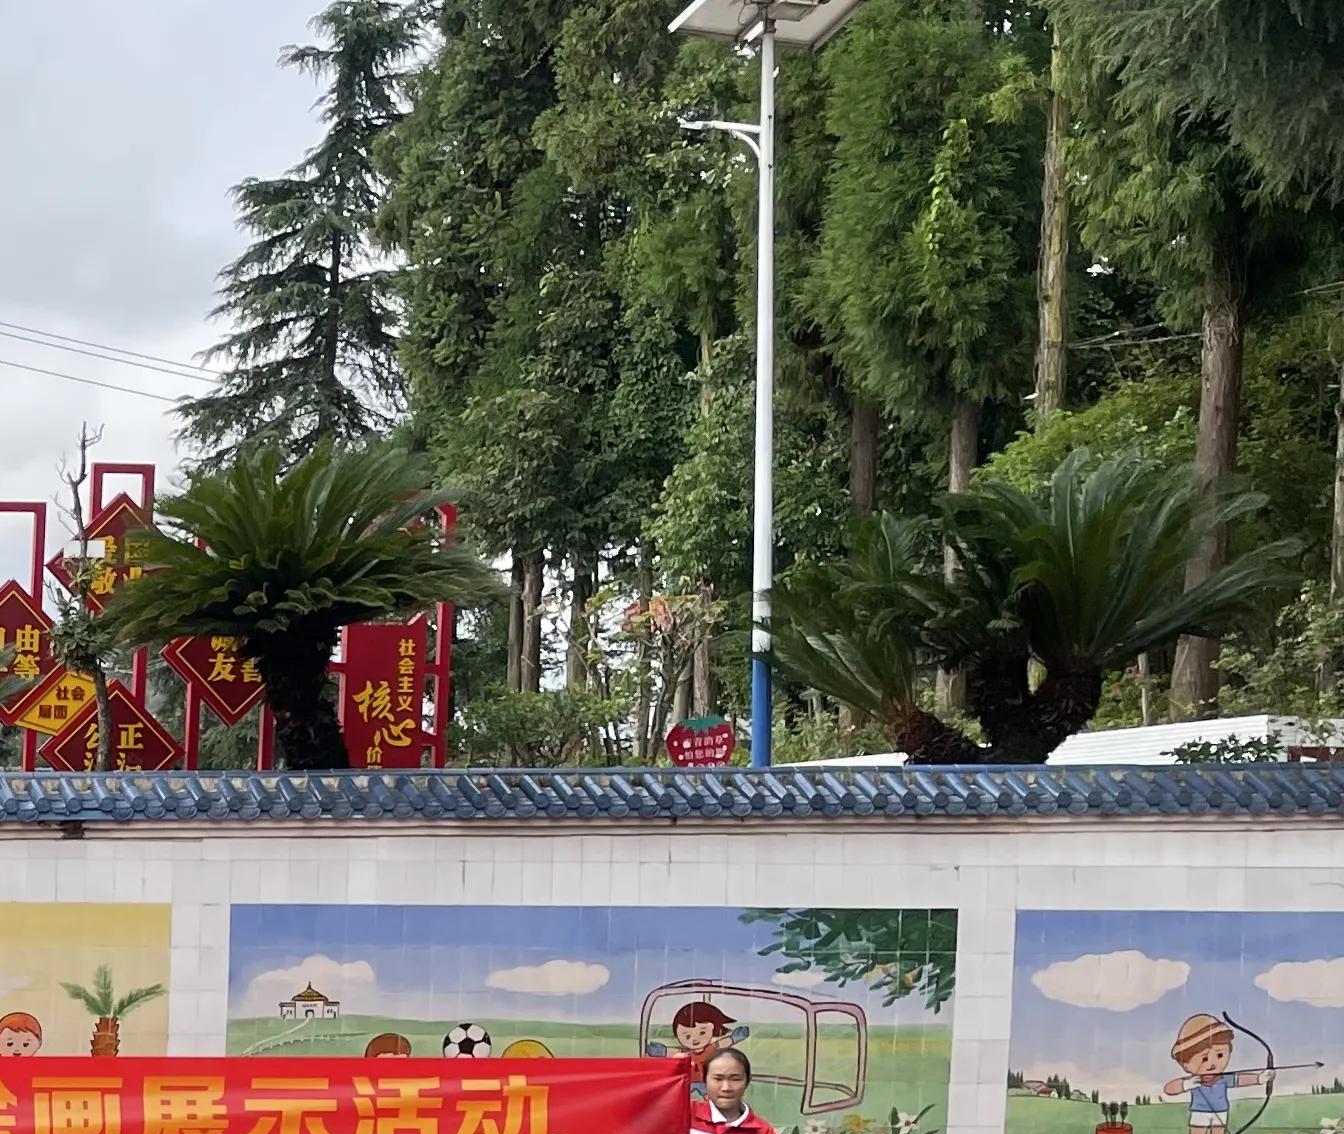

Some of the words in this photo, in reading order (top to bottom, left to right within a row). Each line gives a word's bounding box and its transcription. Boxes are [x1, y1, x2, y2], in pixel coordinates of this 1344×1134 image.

[395, 639, 417, 713] 社会主义
[56, 685, 86, 701] 社会
[366, 741, 384, 768] 价
